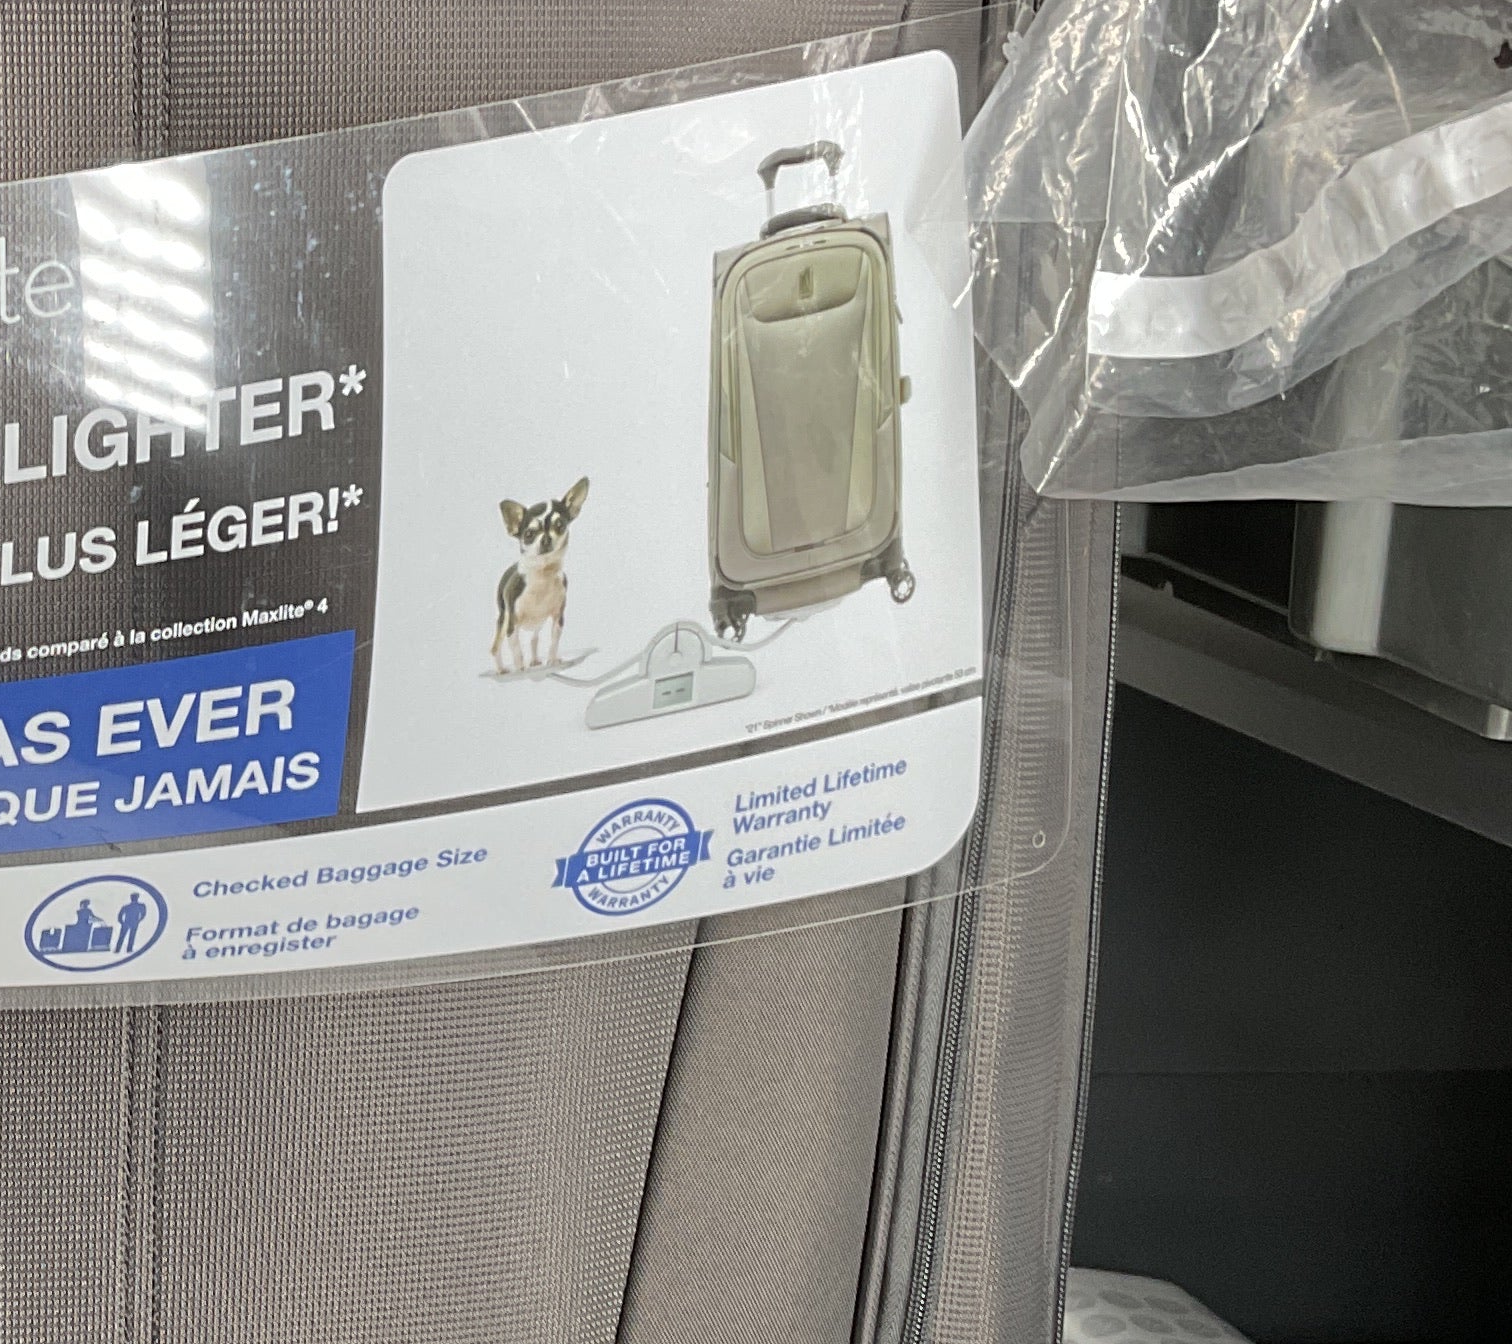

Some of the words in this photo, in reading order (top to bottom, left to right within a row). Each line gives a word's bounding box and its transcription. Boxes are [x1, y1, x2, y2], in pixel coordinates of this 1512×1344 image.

[26, 636, 109, 661] comparé
[113, 630, 126, 648] à
[129, 628, 146, 646] la
[150, 615, 237, 643] collection
[317, 598, 329, 614] 4
[96, 679, 295, 757] EVER
[114, 751, 320, 813] JAMAIS
[735, 778, 816, 813] Limited
[823, 759, 907, 793] Lifetime
[596, 810, 680, 844] WARRANTY
[733, 799, 832, 835] Warranty
[586, 846, 642, 867] BUILT
[648, 838, 686, 856] FOR
[727, 834, 820, 867] Garantie
[829, 813, 906, 846] Limitée
[193, 870, 308, 898] Checked
[316, 856, 428, 885] Baggage
[436, 845, 488, 868] Size
[576, 869, 590, 883] A
[598, 851, 691, 880] LIFETIME
[723, 871, 736, 889] à
[743, 866, 775, 886] vie
[588, 874, 669, 908] WARRANTY
[186, 920, 279, 943] Format
[286, 913, 318, 933] de
[325, 905, 420, 931] bagage
[182, 942, 196, 959] à
[205, 933, 336, 960] enregister
